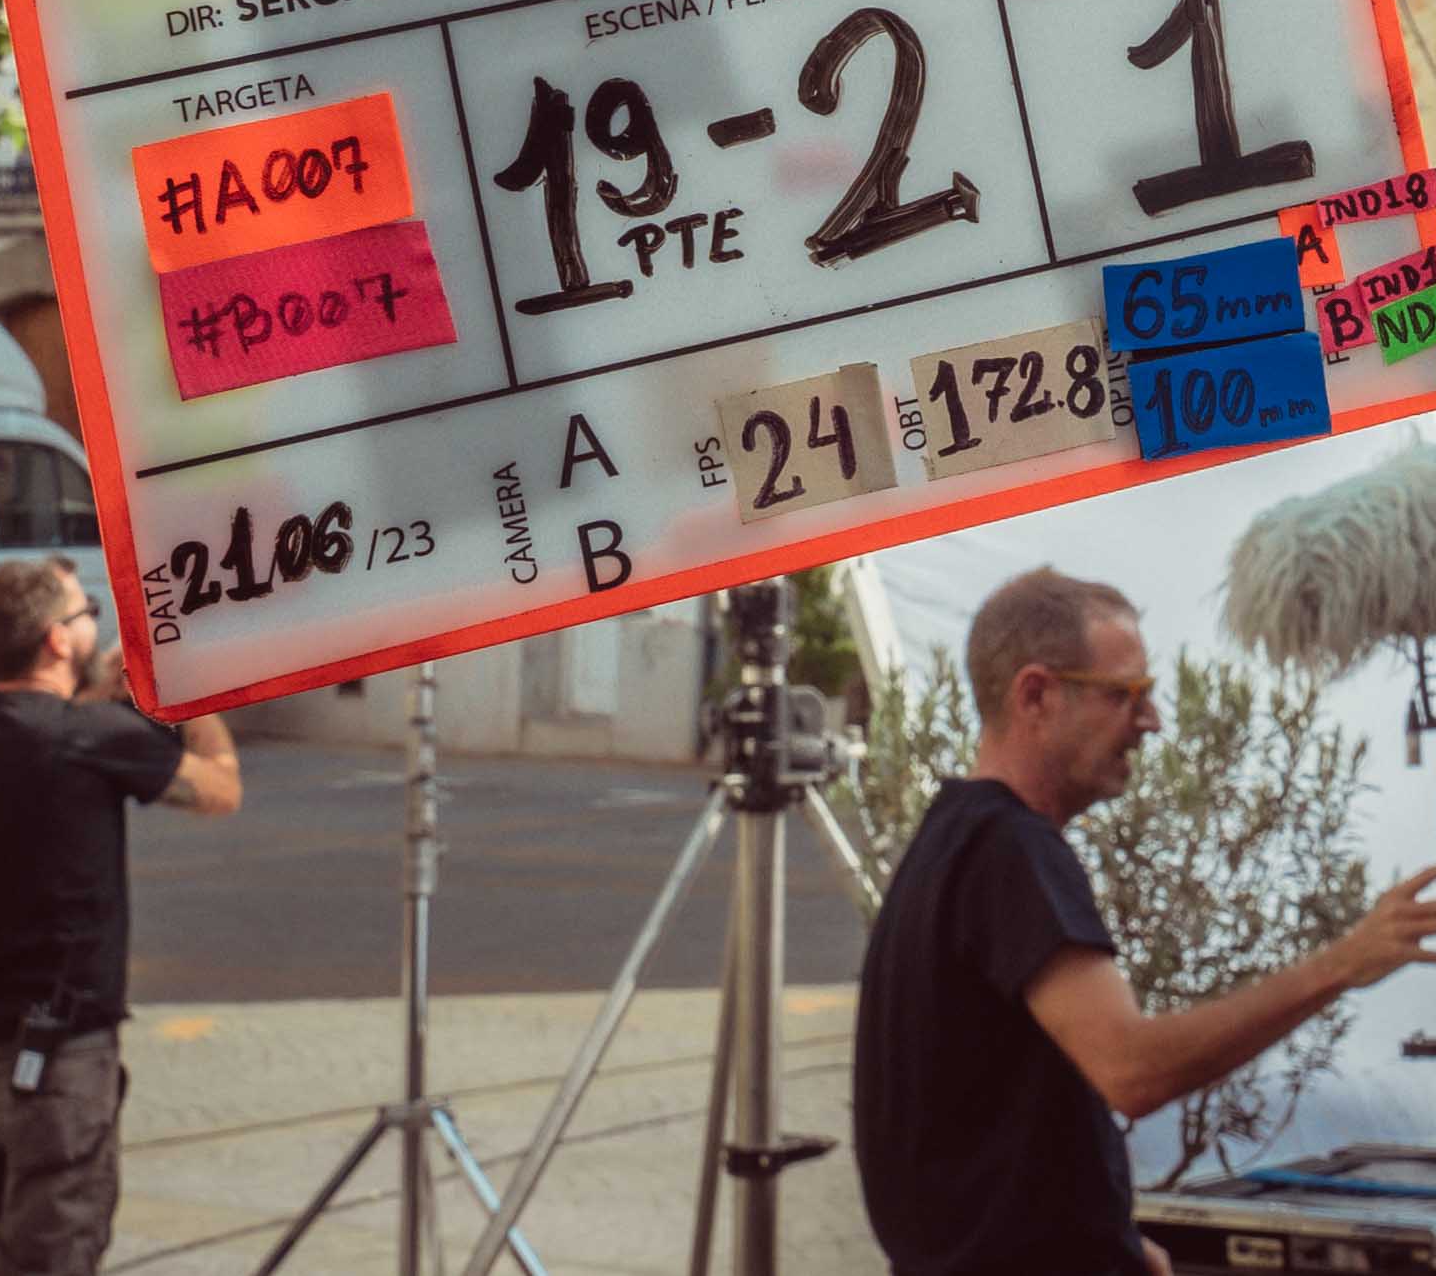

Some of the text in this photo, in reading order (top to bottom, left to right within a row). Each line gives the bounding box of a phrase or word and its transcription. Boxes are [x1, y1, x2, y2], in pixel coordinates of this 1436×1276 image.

[166, 6, 222, 38] DIR:
[173, 73, 316, 123] TARGETA
[158, 135, 370, 235] #A007
[617, 208, 746, 278] PTE
[1297, 224, 1329, 267] A
[1324, 298, 1364, 347] B
[896, 396, 928, 452] OBT
[928, 345, 1107, 457] 172.8
[559, 413, 620, 489] A
[695, 436, 728, 489] FPS
[742, 396, 857, 509] 24
[492, 460, 539, 584] CÀMERA
[577, 519, 633, 593] B
[144, 563, 182, 645] DATA
